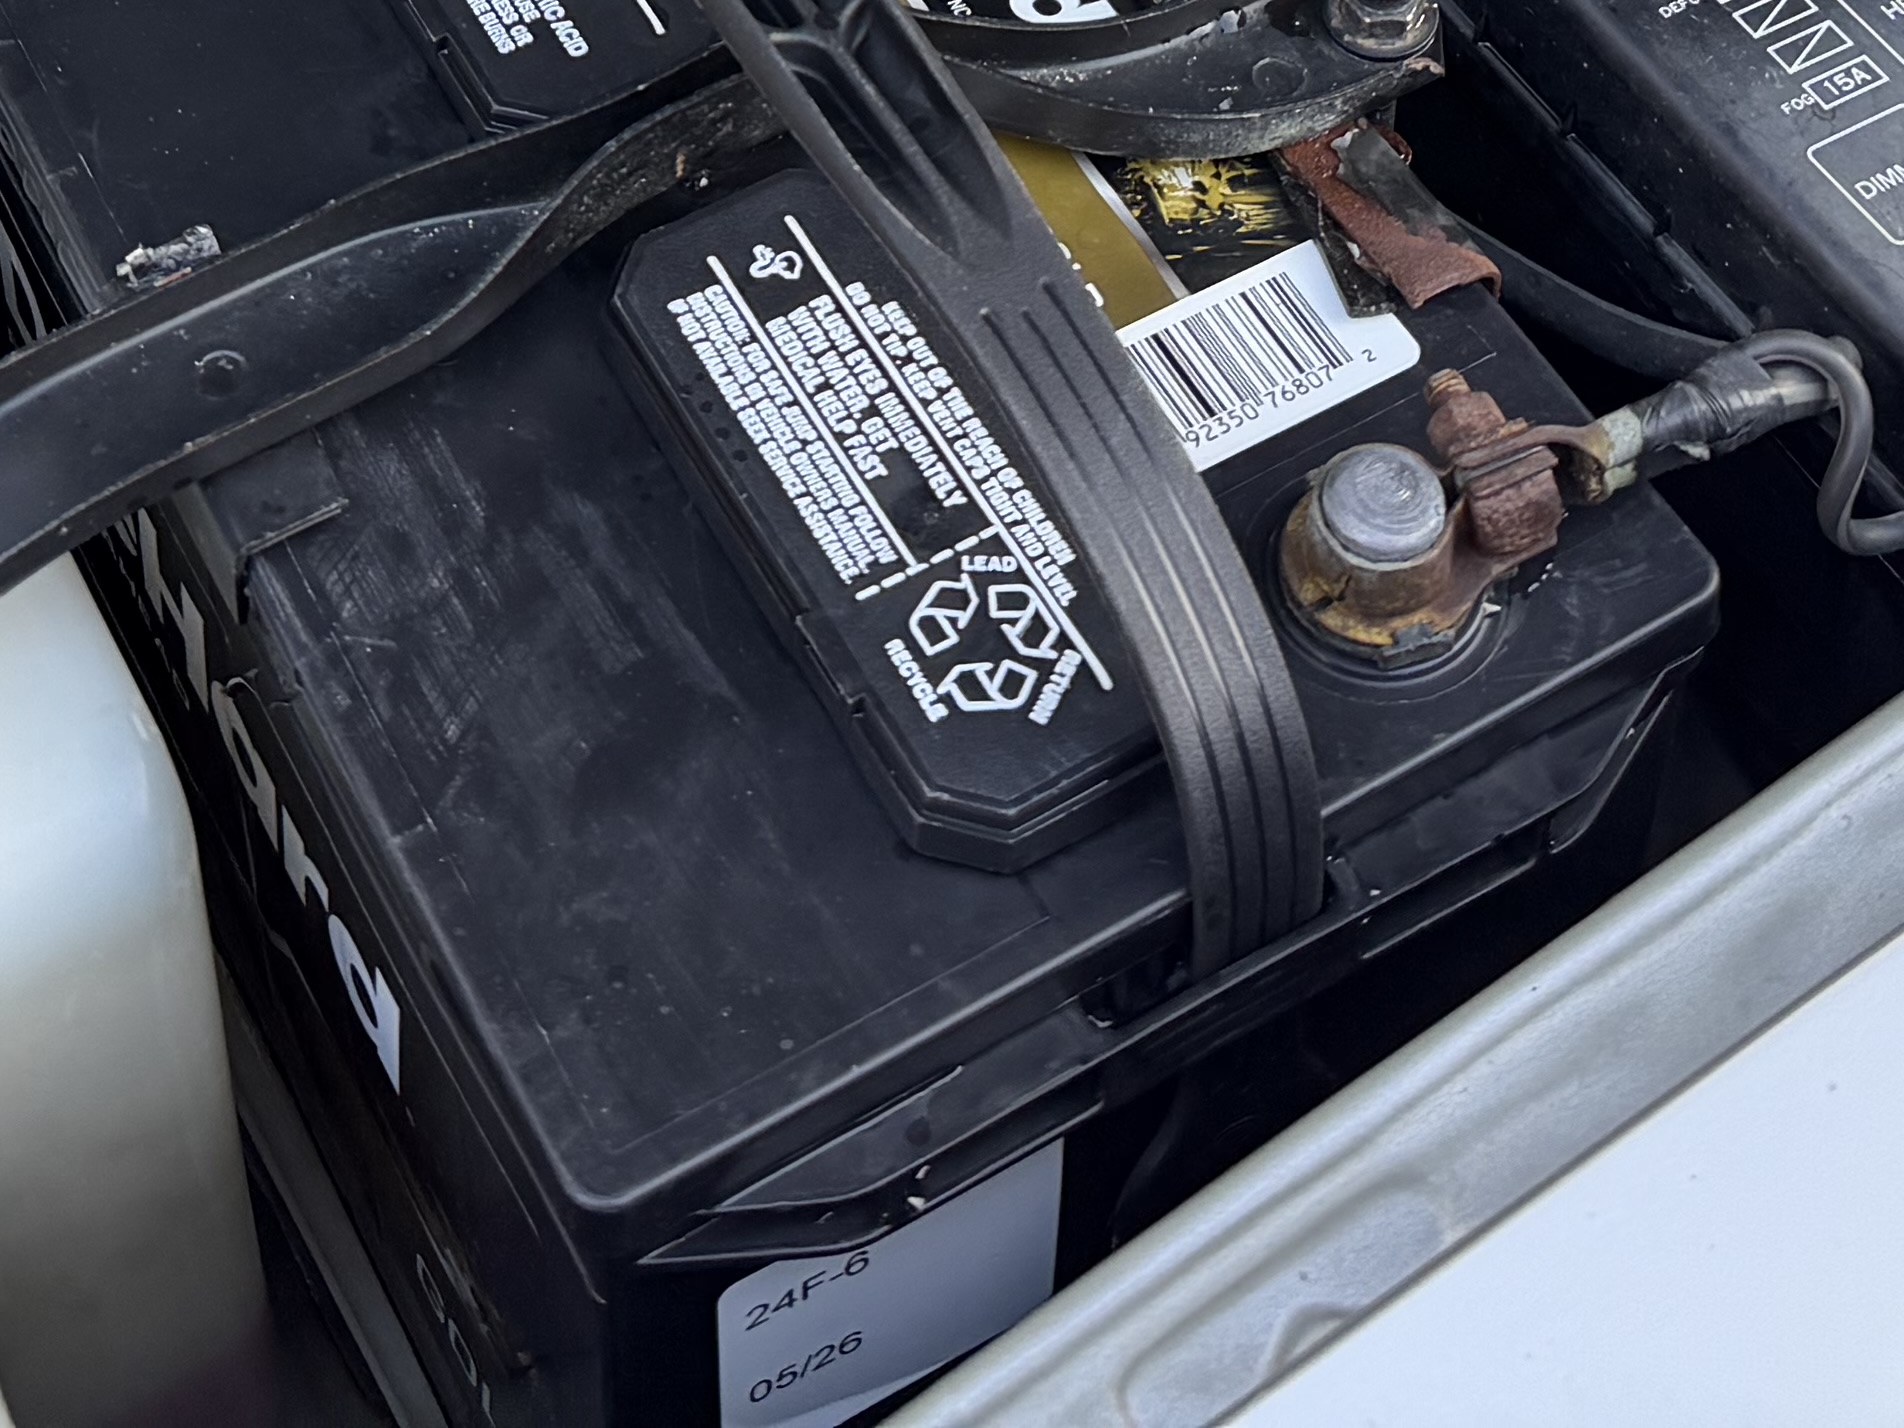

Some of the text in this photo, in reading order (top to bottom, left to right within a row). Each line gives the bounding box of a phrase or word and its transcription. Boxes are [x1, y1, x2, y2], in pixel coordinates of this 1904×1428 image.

[509, 24, 534, 48] OR
[550, 19, 589, 57] ACID
[1780, 93, 1815, 114] FOG
[1823, 67, 1872, 98] 15A
[765, 316, 889, 480] MEDICAL HELP FAST
[787, 305, 831, 354] WITH
[860, 416, 900, 453] GET
[808, 294, 968, 508] FLUSH EYES IMMEDIATELY
[1184, 347, 1377, 450] 92350 76807 2
[960, 555, 1017, 572] LEAD
[883, 638, 949, 722] RECYCLE
[745, 1242, 870, 1331] 24F-6
[749, 1330, 863, 1403] 05/26
